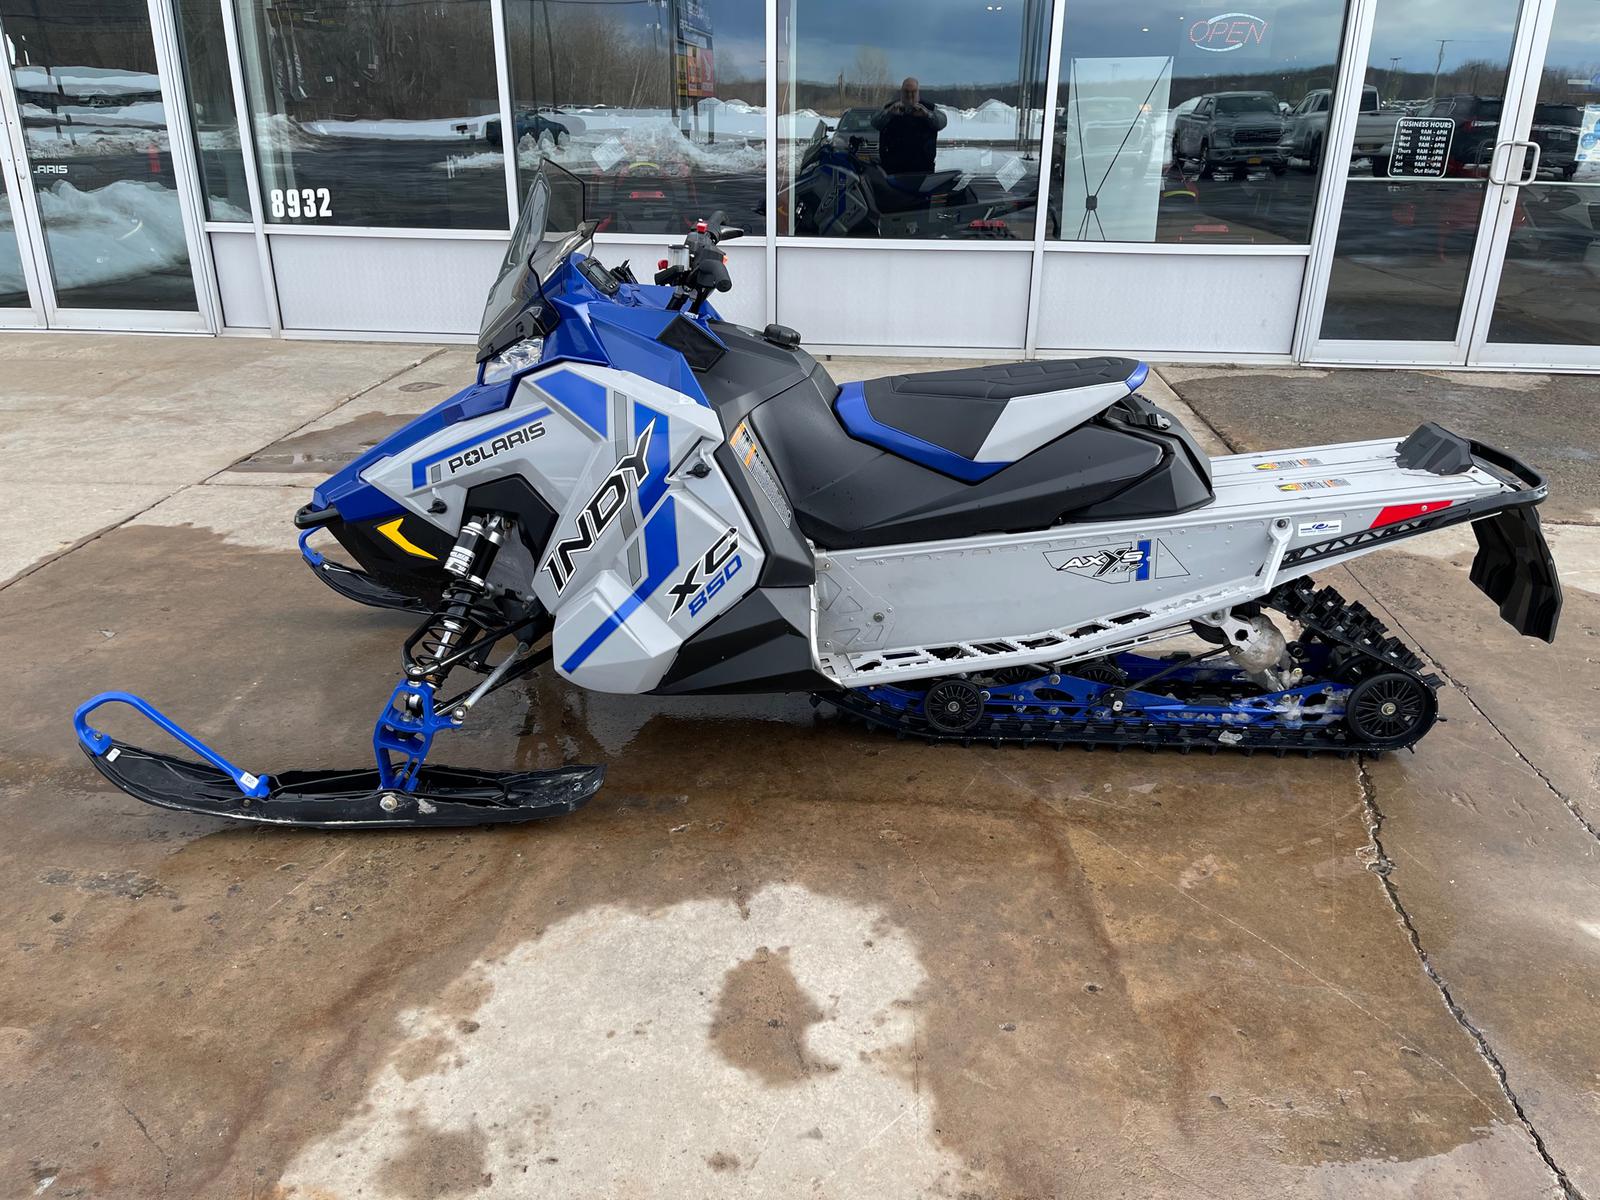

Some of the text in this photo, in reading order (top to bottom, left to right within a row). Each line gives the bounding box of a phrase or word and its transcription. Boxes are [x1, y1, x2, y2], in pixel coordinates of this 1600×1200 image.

[1190, 20, 1267, 43] OPEN
[270, 188, 333, 218] 8932
[448, 421, 546, 474] POLARIS
[541, 416, 656, 598] INDY
[665, 527, 739, 622] XC
[688, 554, 742, 618] 850
